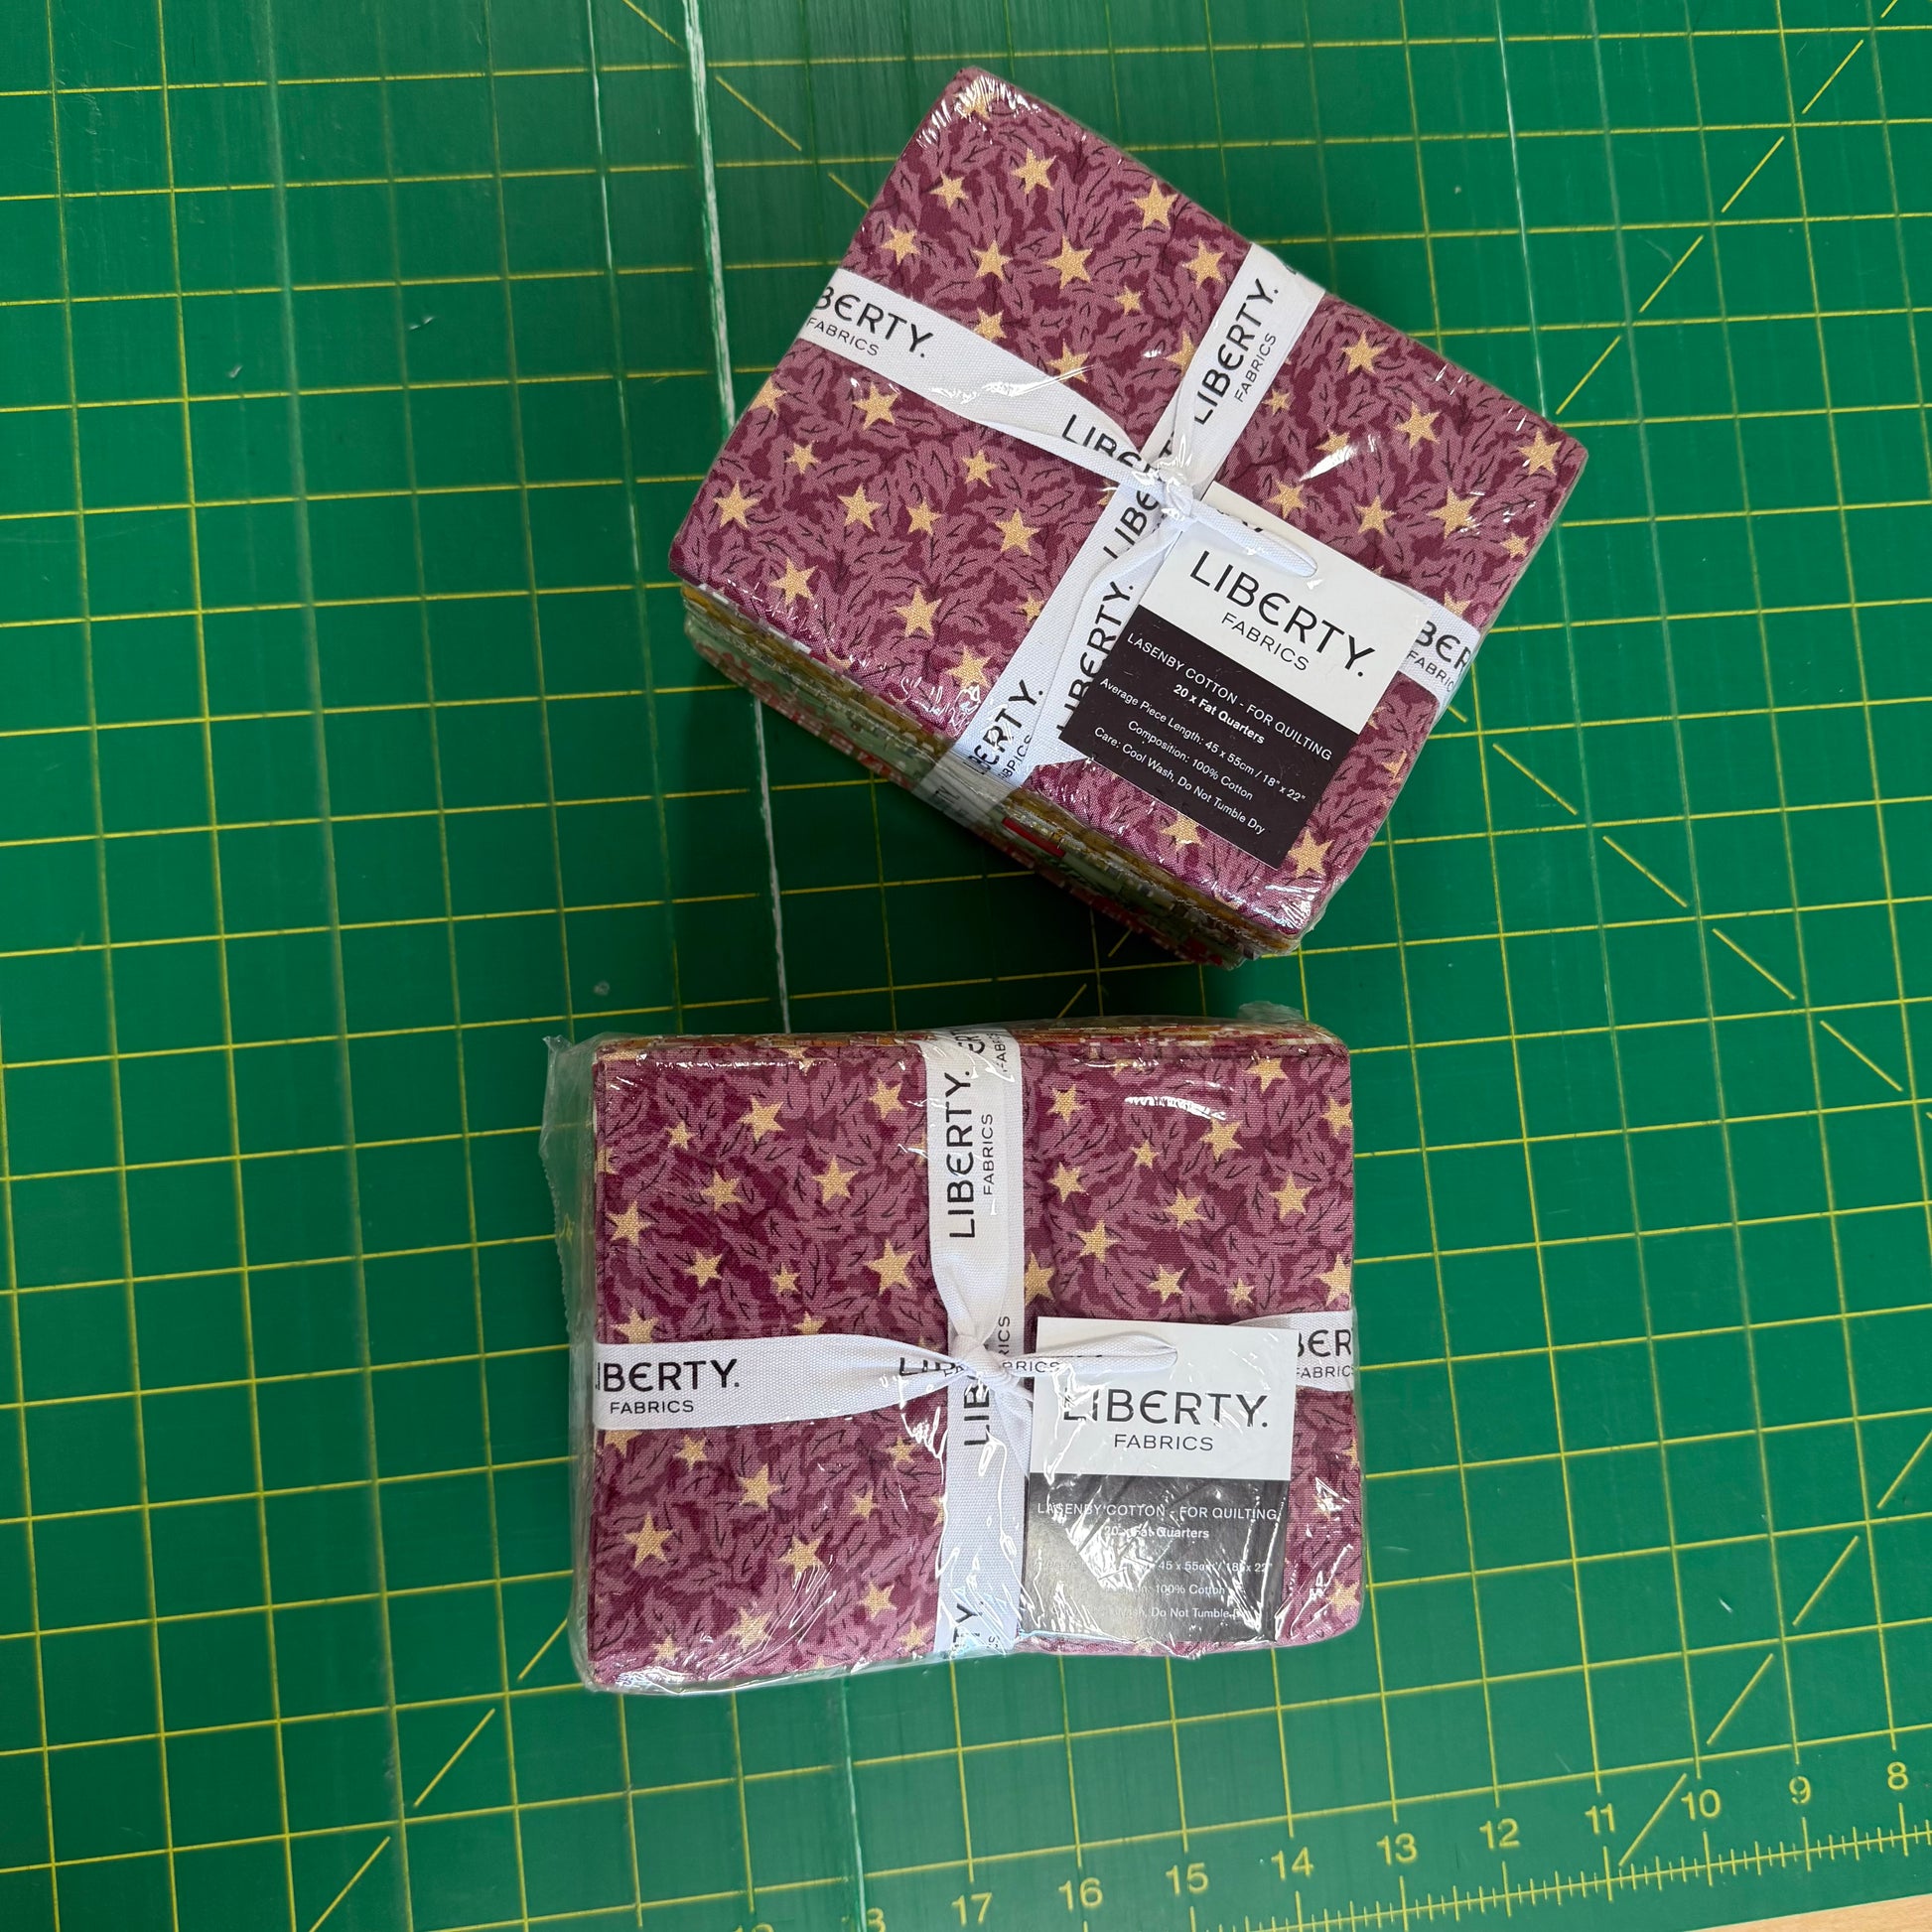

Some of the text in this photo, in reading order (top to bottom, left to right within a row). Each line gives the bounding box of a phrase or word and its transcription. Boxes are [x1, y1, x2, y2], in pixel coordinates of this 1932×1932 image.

[806, 317, 880, 356] FABRICS
[1194, 278, 1280, 426] LIBERTY.
[1234, 333, 1277, 403] FABRICS
[1189, 550, 1376, 678] LIBERTY.
[1221, 612, 1310, 672] FABRICS
[1099, 677, 1140, 707] Average
[1139, 700, 1168, 724] Piece
[1167, 717, 1204, 746] Length:
[1204, 740, 1220, 754] 45
[1227, 753, 1256, 776] 55cm
[1127, 632, 1185, 672] LASENBY
[1184, 667, 1239, 706] COTTON
[1246, 703, 1274, 727] FOR
[1274, 721, 1333, 761] QUILTING
[1173, 684, 1189, 698] 20
[1198, 698, 1218, 716] Fat
[1217, 710, 1266, 745] Quarters
[1094, 727, 1266, 836] Care: Cool Wash, Do Not Tumble Dry
[1128, 720, 1254, 801] Composition: 100% Cotton
[943, 1071, 976, 1239] LIBERTY.
[981, 1113, 996, 1196] FABRICS
[610, 1400, 695, 1415] FABRICS
[1063, 1387, 1269, 1429] LIBERTY.
[1114, 1433, 1214, 1452] FABRICS
[1106, 1504, 1167, 1517] COTTON
[1179, 1506, 1208, 1519] FOR
[1211, 1507, 1278, 1520] QUILTING
[1156, 1526, 1210, 1539] Quarters
[1156, 1584, 1186, 1594] 100%
[1158, 1560, 1173, 1571] 45
[1170, 1607, 1189, 1618] Not
[1191, 1607, 1230, 1619] Tumble
[951, 1761, 1909, 1927] 17 16 15 14 13 12 11 10 9 8
